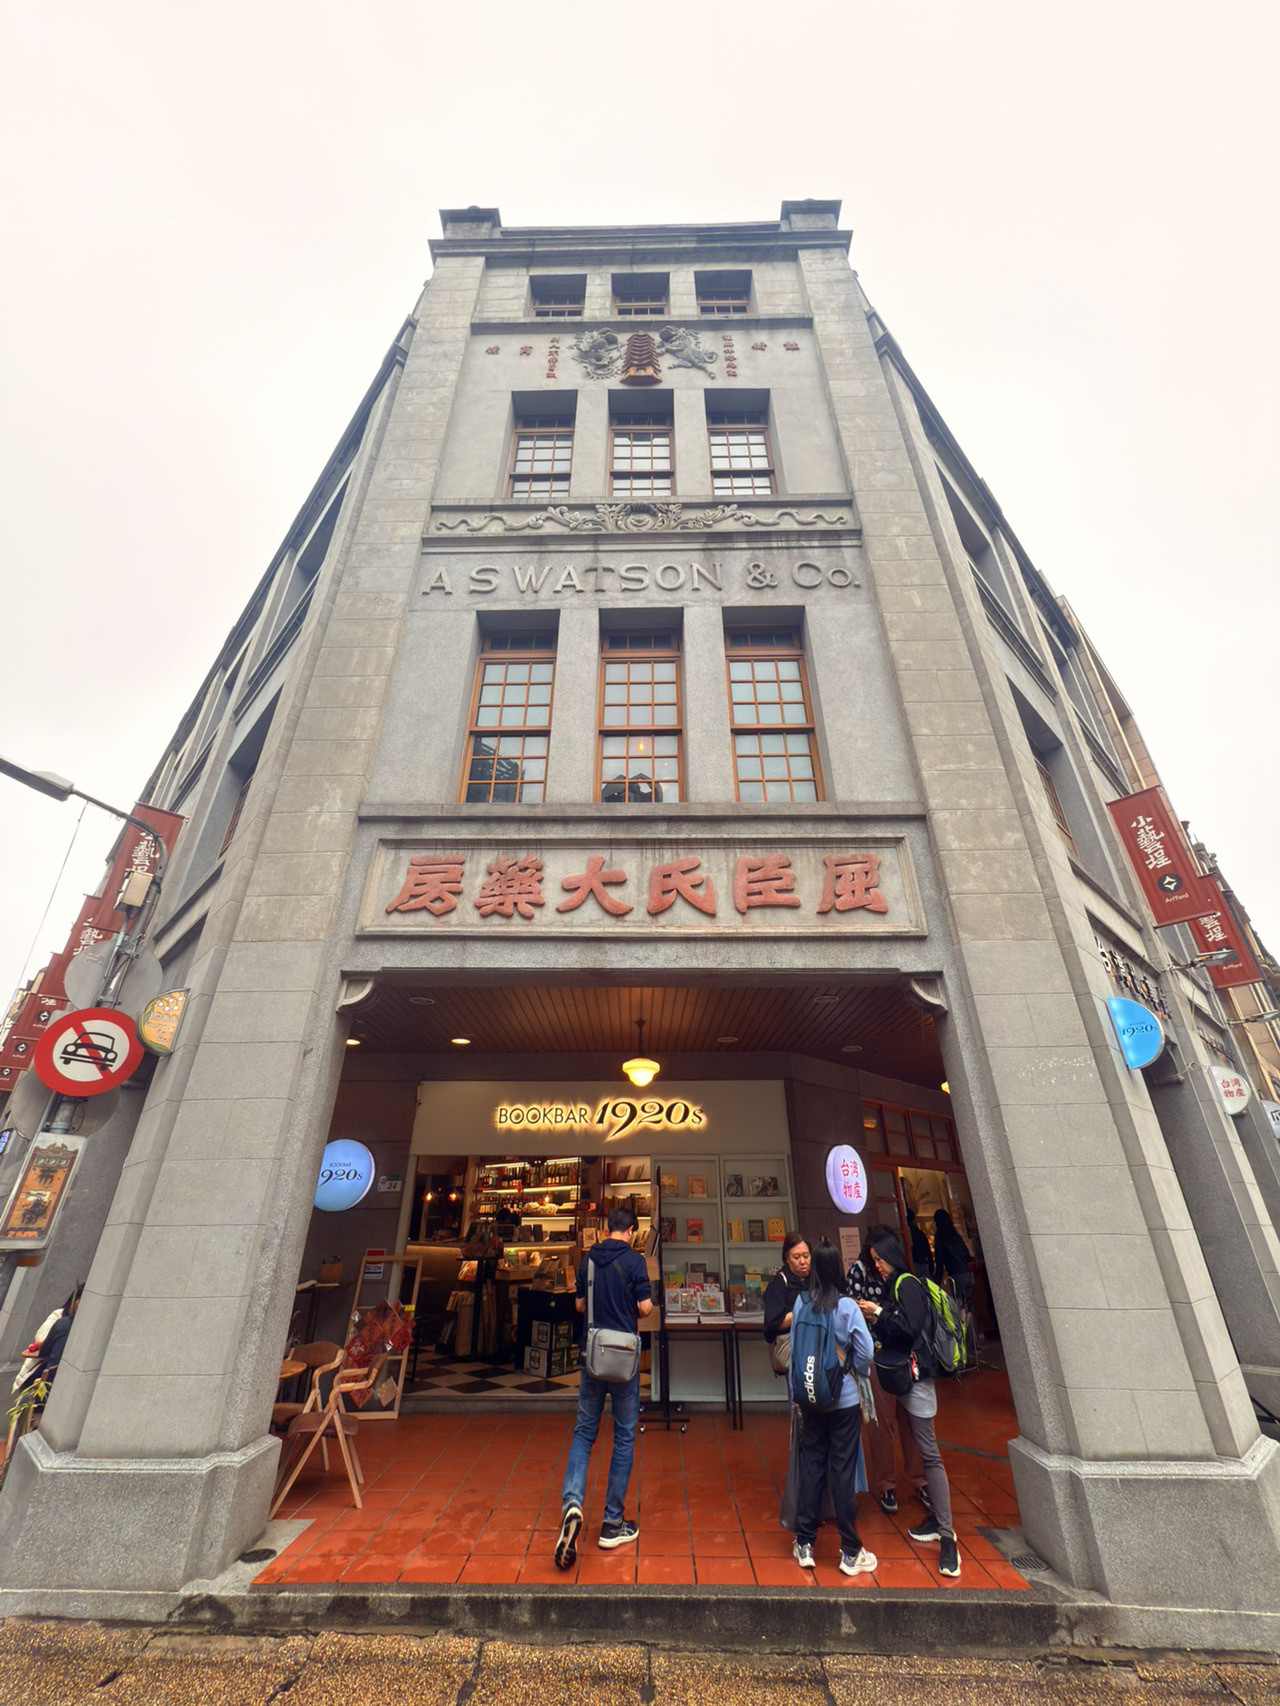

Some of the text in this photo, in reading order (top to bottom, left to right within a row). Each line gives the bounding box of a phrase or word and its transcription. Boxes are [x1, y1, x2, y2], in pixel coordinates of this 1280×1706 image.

[422, 560, 861, 595] A S WATSON & Co.
[499, 1101, 704, 1138] BOOKBAR 1920s
[319, 1168, 363, 1187] 920s
[804, 1355, 816, 1404] adidas
